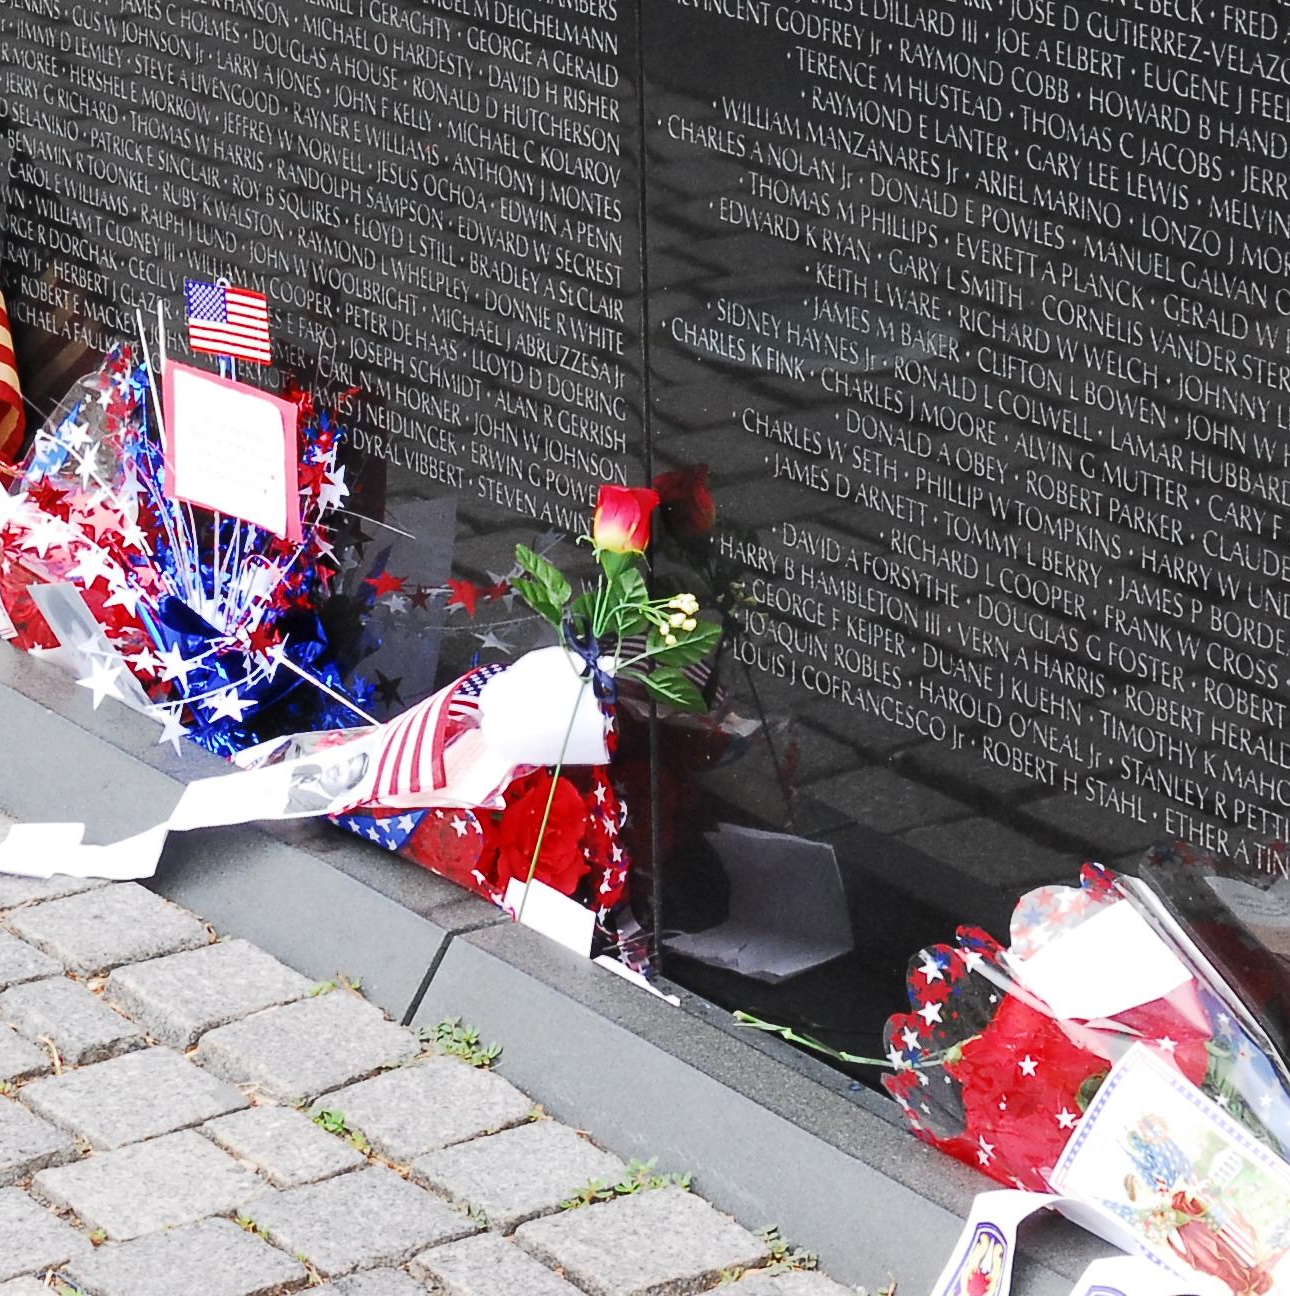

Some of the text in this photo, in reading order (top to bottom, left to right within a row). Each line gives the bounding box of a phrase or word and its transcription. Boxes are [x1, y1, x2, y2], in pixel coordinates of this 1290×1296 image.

[486, 288, 624, 355] DONNIE R WHITE
[672, 318, 805, 382] CHARLES K FINK
[495, 390, 625, 453] ALAN R GERRISH
[743, 408, 897, 482] CHARLES W SETH
